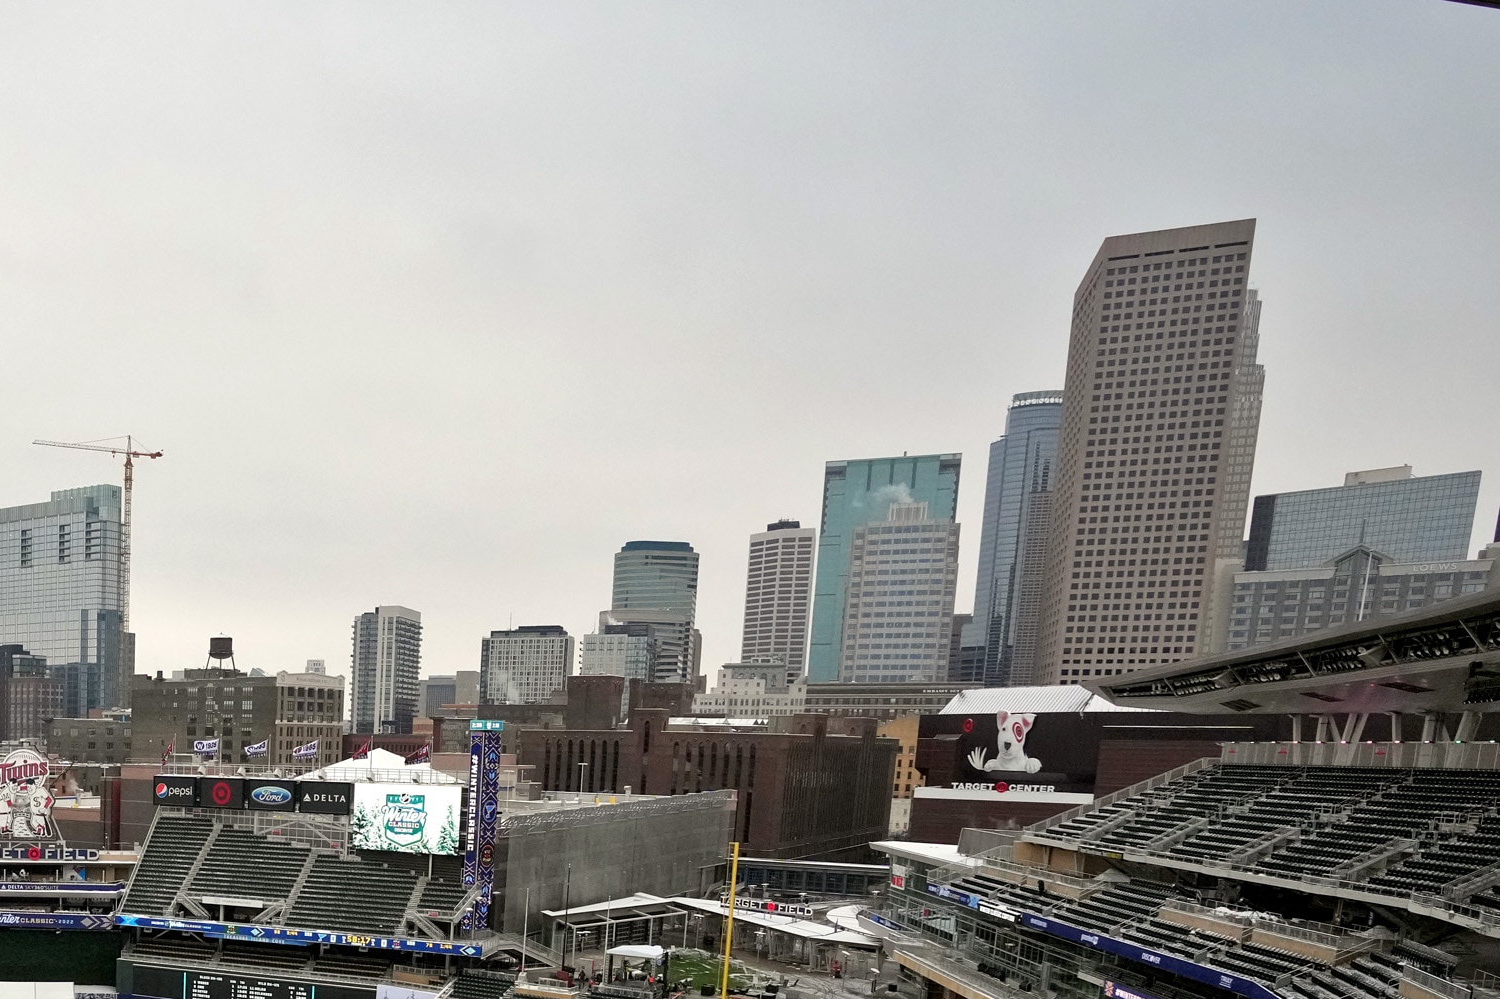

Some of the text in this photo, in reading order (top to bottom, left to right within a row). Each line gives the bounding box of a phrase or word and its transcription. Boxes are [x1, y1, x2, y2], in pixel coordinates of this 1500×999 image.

[1413, 564, 1457, 572] LOEWS
[169, 786, 192, 797] pepsi
[951, 782, 1056, 793] TARGET CENTER
[256, 788, 282, 802] Ford
[314, 794, 346, 802] DELTA
[468, 755, 478, 851] #WINTERCLASSIC
[382, 805, 427, 823] Winter
[45, 849, 100, 860] FIELD
[778, 904, 813, 916] FIELD
